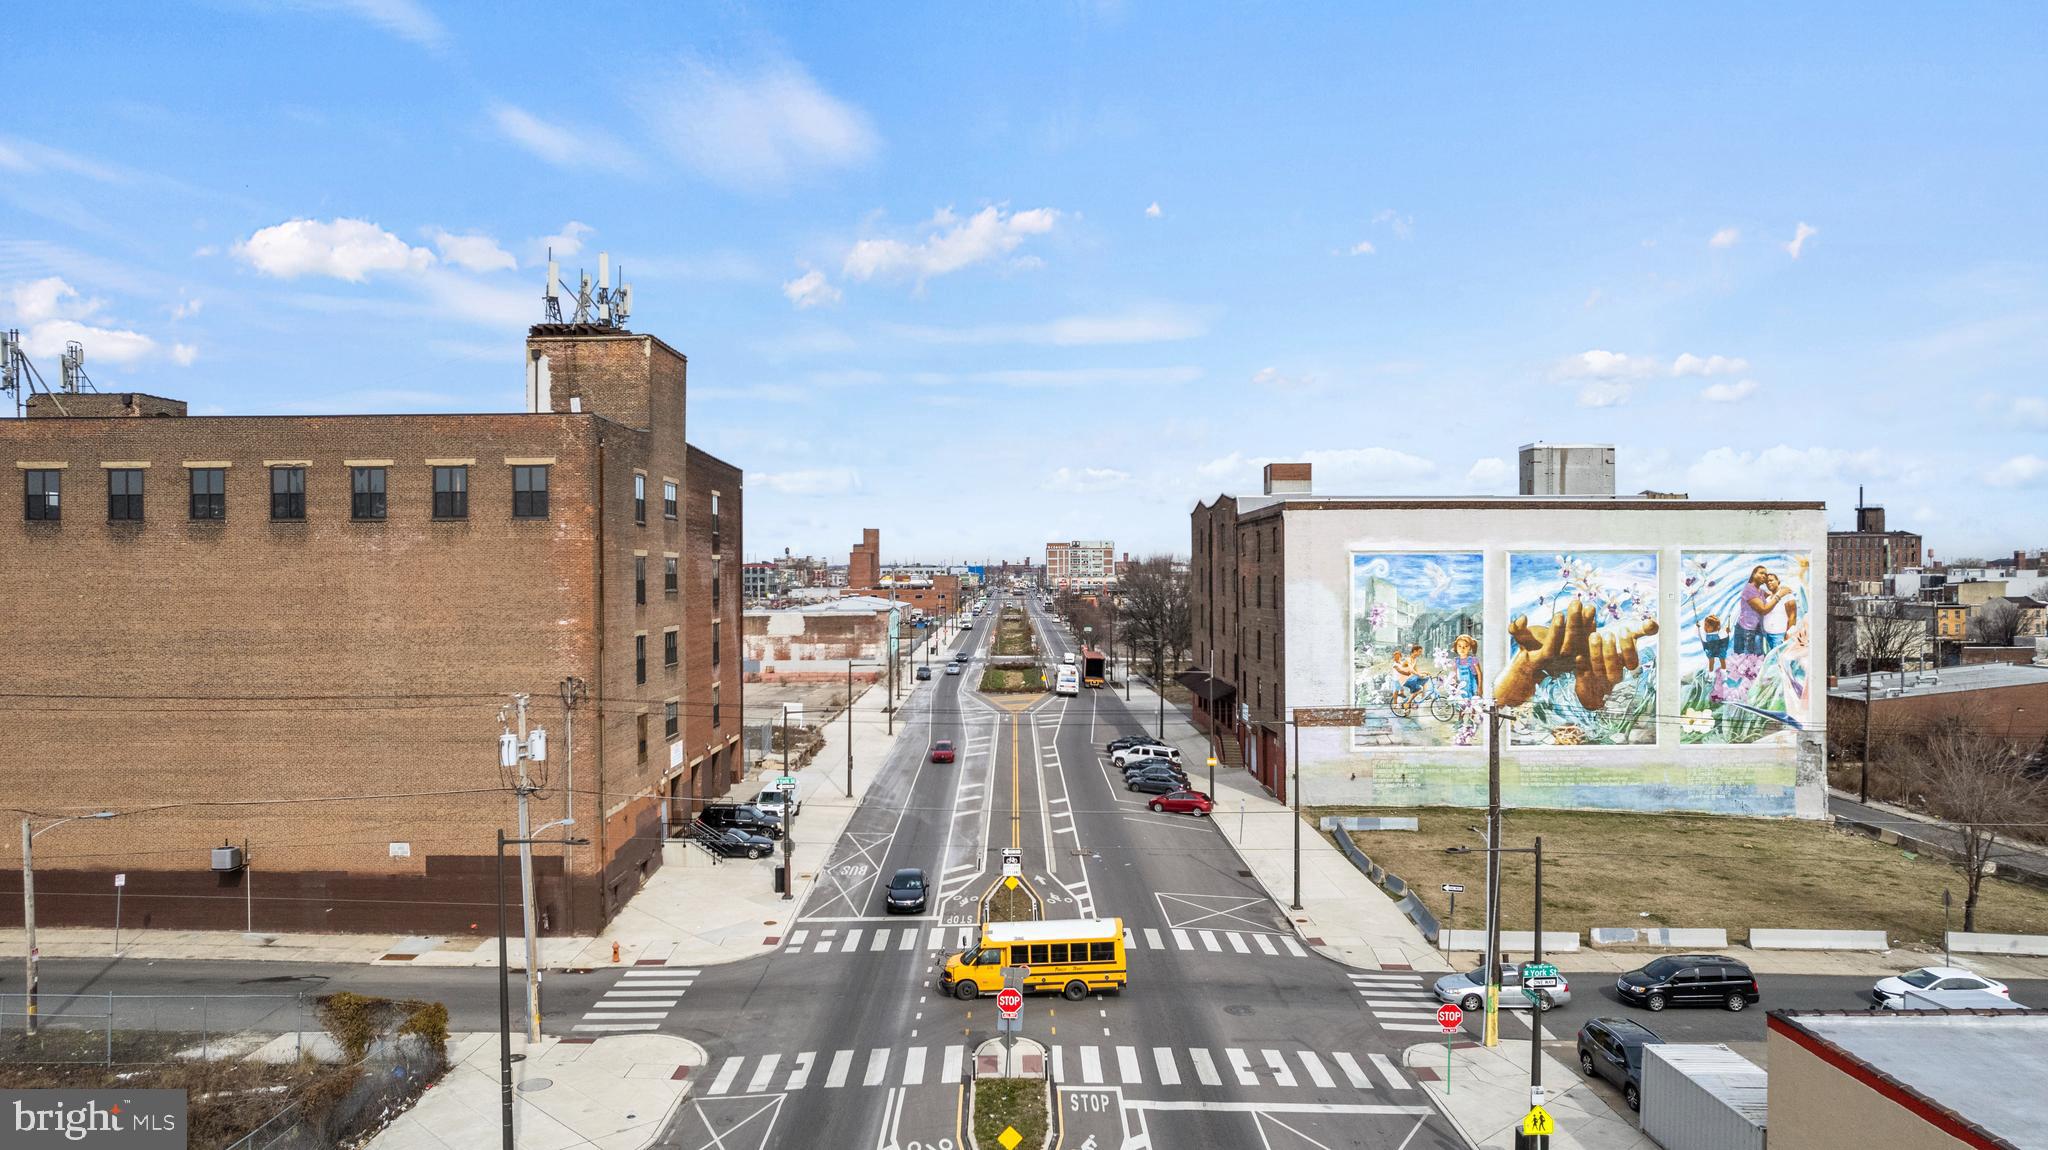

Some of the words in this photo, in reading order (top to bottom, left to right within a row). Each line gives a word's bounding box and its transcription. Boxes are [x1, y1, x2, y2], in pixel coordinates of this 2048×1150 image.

[840, 865, 868, 876] BUS
[946, 915, 973, 924] STOP
[1530, 969, 1547, 977] York
[1549, 968, 1557, 976] St
[999, 995, 1020, 1006] STOP
[1439, 1011, 1461, 1021] STOP
[1071, 1093, 1109, 1112] STOP
